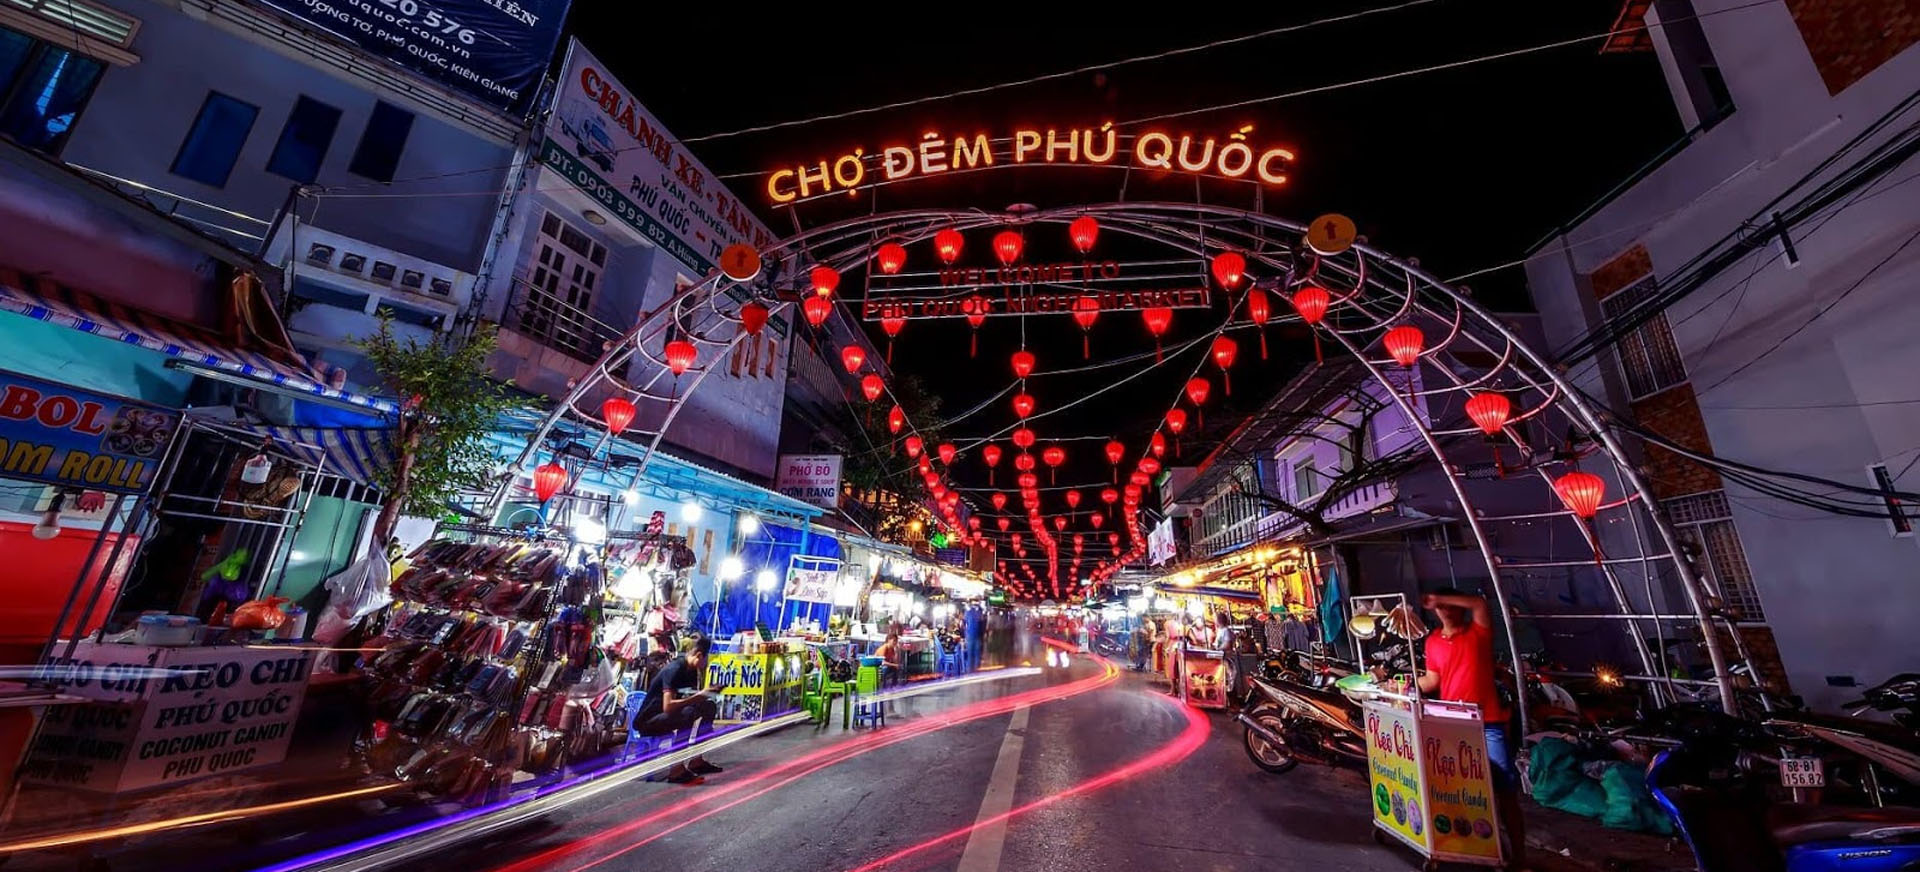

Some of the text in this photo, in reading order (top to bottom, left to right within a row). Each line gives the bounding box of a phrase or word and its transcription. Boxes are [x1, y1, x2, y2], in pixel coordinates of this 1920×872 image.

[422, 10, 476, 45] 576
[480, 78, 520, 101] GIANG
[674, 152, 707, 198] XE
[767, 121, 1296, 203] CHỢ ĐÊM PHÚ QUỐC
[550, 147, 575, 176] ĐT:
[576, 169, 616, 205] 0903
[616, 201, 647, 228] 999
[648, 222, 667, 243] 812
[630, 174, 659, 210] PHÚ
[58, 451, 145, 488] ROLL
[806, 487, 835, 498] RANG
[709, 660, 738, 688] Thốt
[740, 660, 763, 689] Nốt
[139, 721, 291, 761] COCONUT CANDY
[162, 756, 206, 780] PHU
